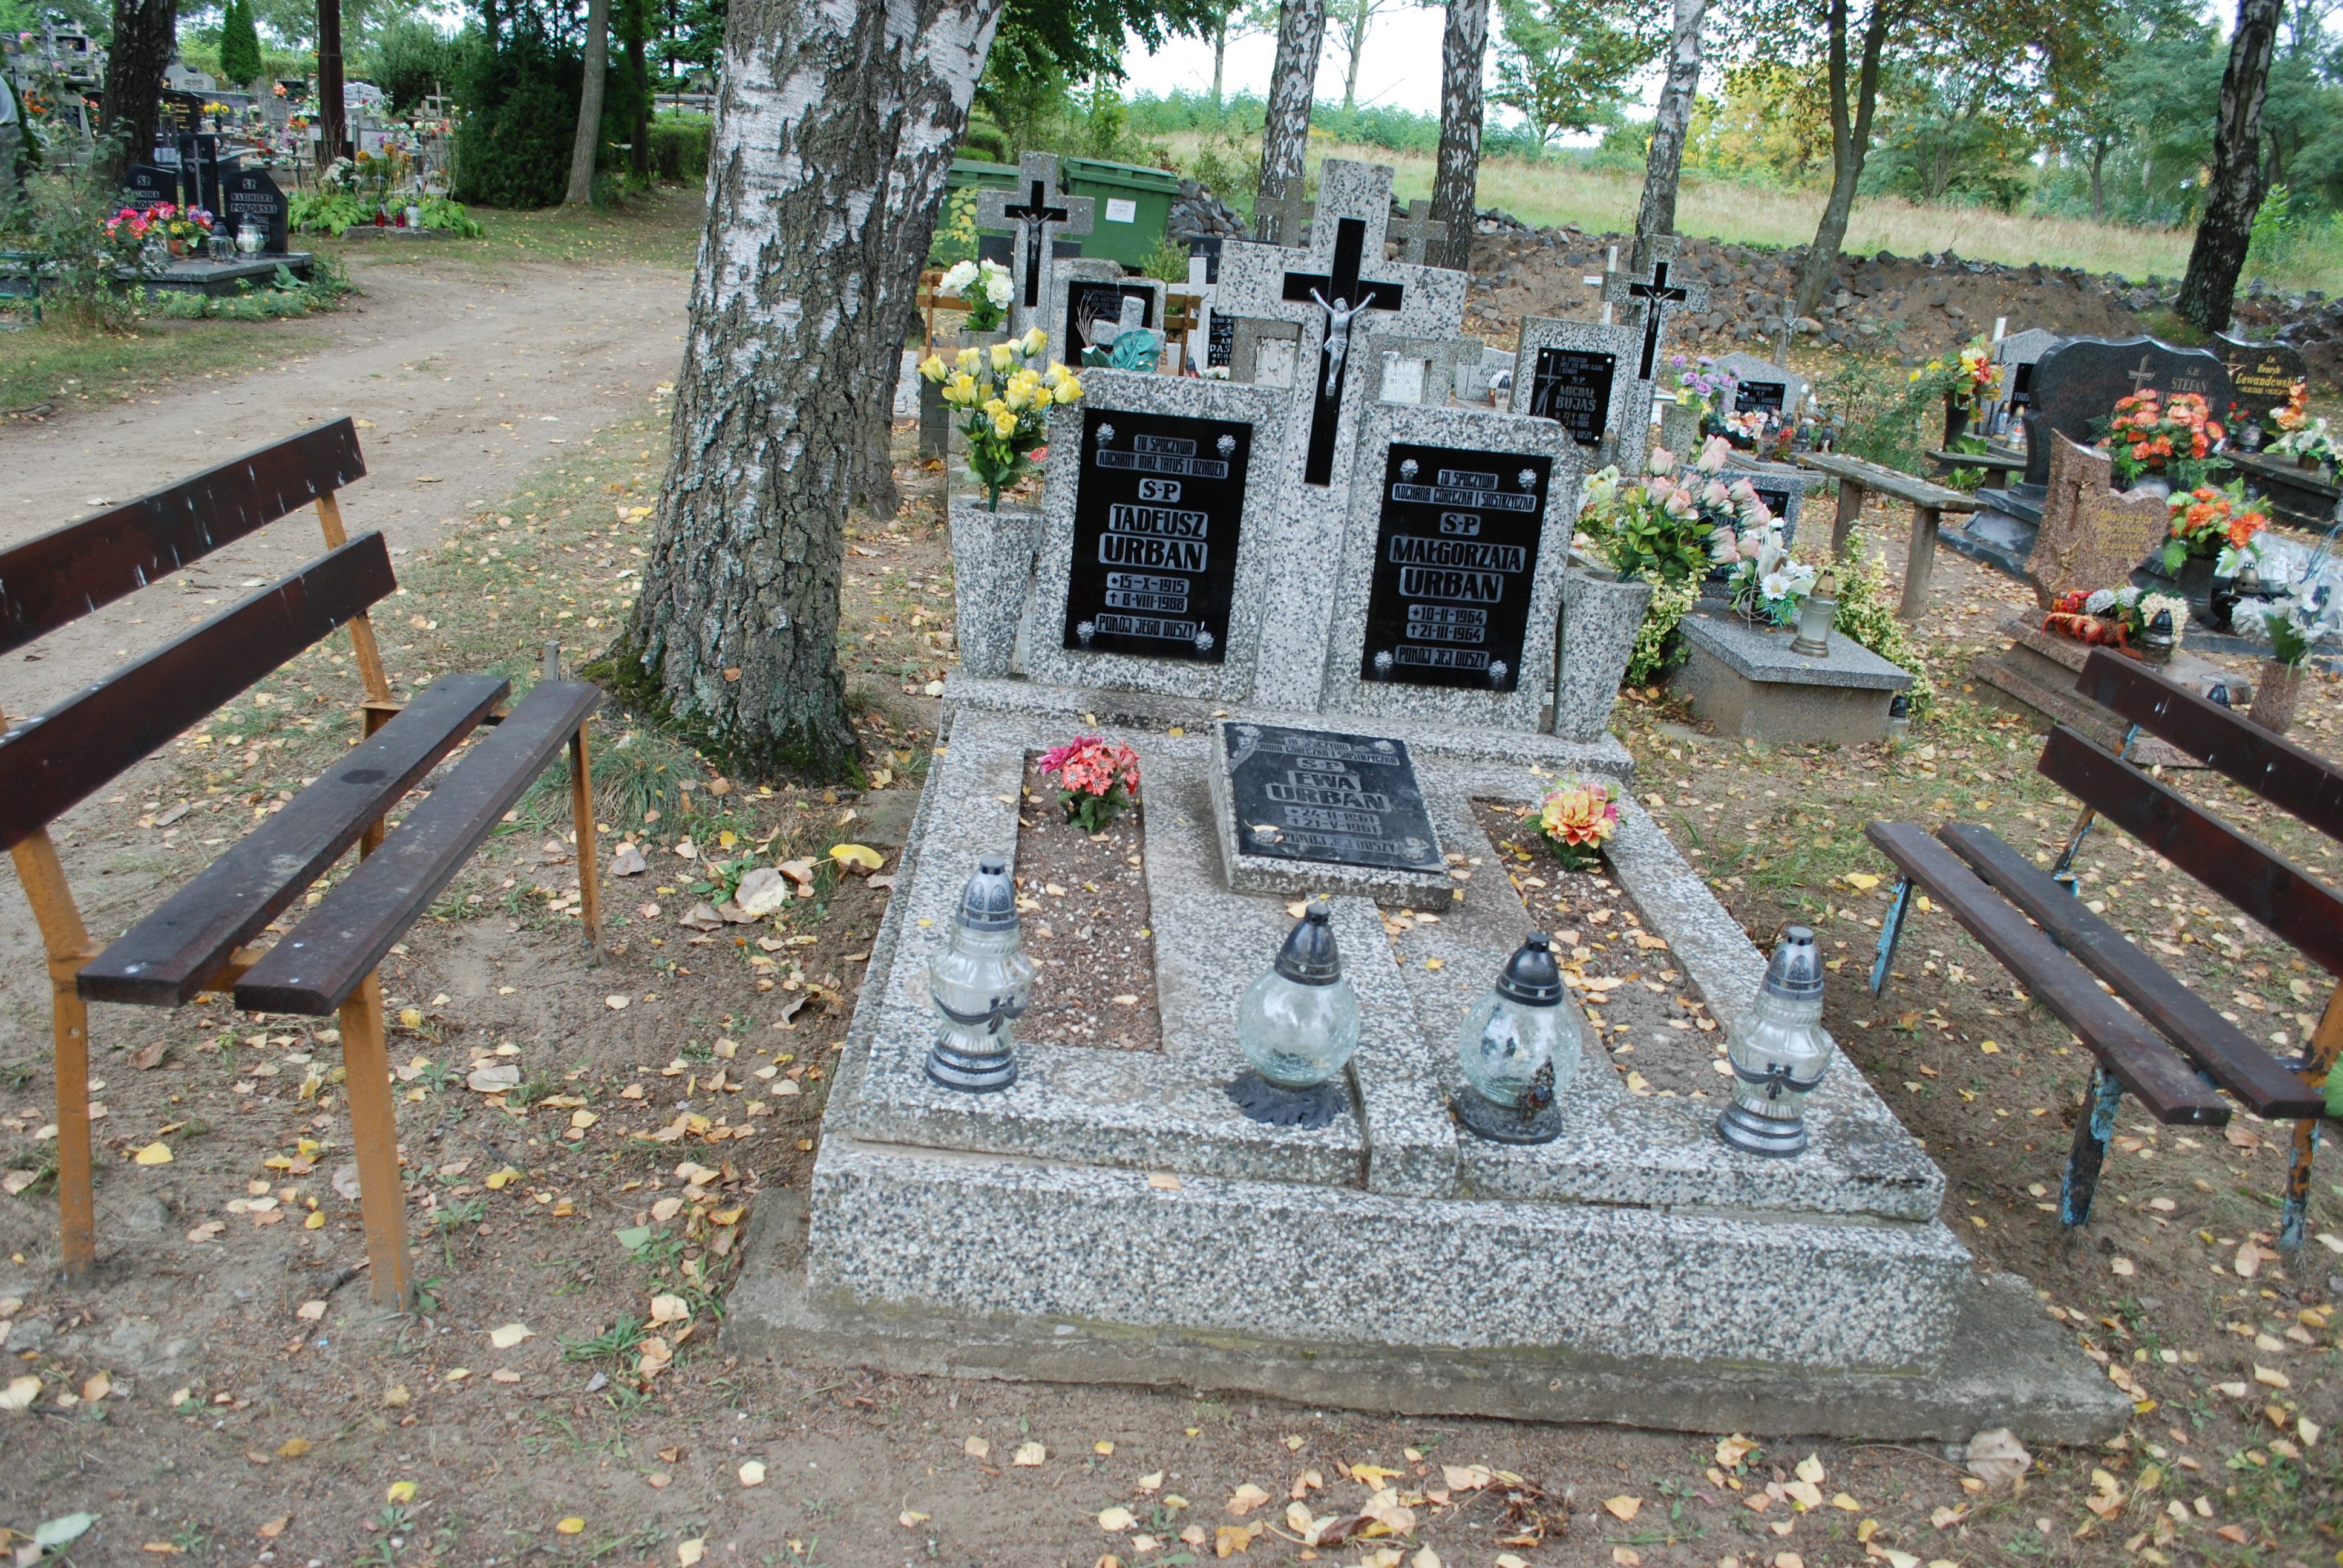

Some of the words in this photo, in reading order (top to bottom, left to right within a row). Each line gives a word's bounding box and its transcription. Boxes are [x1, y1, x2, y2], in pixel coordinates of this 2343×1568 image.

[231, 194, 272, 202] KAZIMIERZ
[231, 204, 277, 213] POKORSKI
[2170, 377, 2208, 393] STEFAN
[2235, 372, 2298, 387] Lewandowski
[1559, 385, 1596, 399] MICHAŁ
[2014, 392, 2029, 401] TRZ
[1555, 396, 1597, 412] BUJAS
[1138, 436, 1147, 450] TU
[1150, 438, 1194, 455] SPOCZYWA
[1099, 452, 1136, 468] KOCHANY
[1192, 462, 1225, 477] DZIADEK
[1441, 471, 1449, 484] TU
[1453, 472, 1495, 489] SPOCZYWA
[1395, 485, 1430, 501] KOCHANA
[1481, 493, 1534, 511] SIOSTRZYCZKA
[1113, 506, 1205, 537] TADEUSZ
[1104, 535, 1203, 570] URBAN
[1393, 538, 1521, 570] MAŁGORZATA
[1404, 569, 1499, 601] URBAN
[1135, 618, 1161, 636] JEGO
[1163, 621, 1194, 638] DUSZY
[1434, 650, 1453, 666] JEJ
[1455, 651, 1487, 669] DUSZY
[1294, 772, 1357, 790] EWA
[1271, 785, 1386, 809] URBAN
